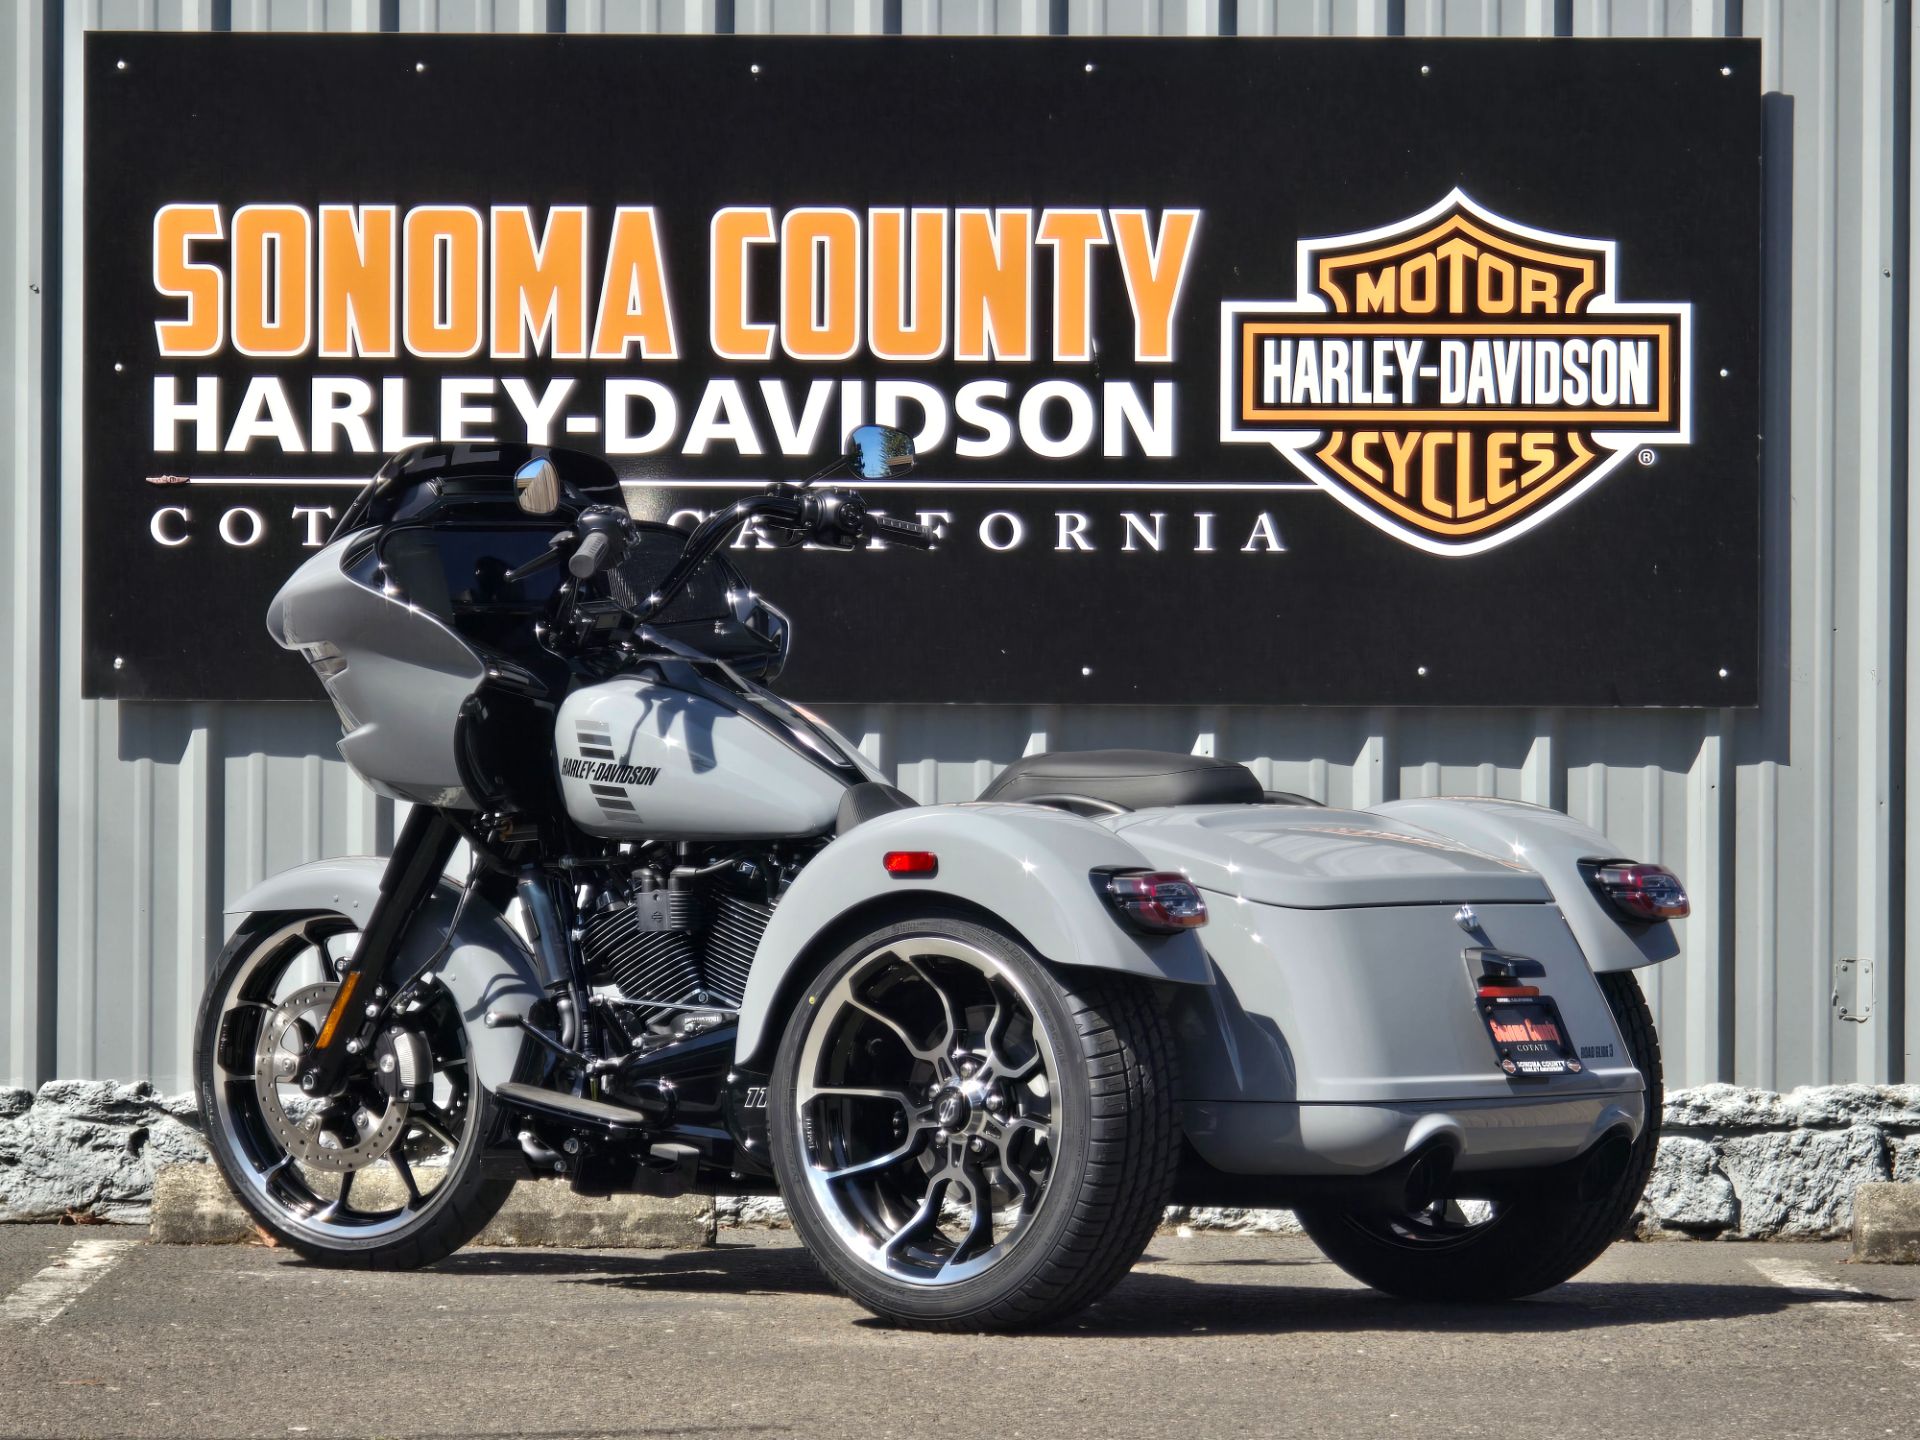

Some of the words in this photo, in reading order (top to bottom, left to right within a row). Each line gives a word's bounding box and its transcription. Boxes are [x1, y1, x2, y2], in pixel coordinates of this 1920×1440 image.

[153, 204, 679, 360] SONOMA
[710, 207, 1200, 362] COUNTY
[1357, 237, 1559, 314] MOTOR
[1264, 338, 1650, 407] HARLEY-DAVIDSON
[153, 376, 1176, 458] HARLEY-DAVIDSON
[1351, 432, 1555, 520] CYCLES
[150, 506, 334, 547] COT
[561, 757, 662, 786] HARLEY-DAVIDSON
[1516, 1043, 1549, 1052] COTATI
